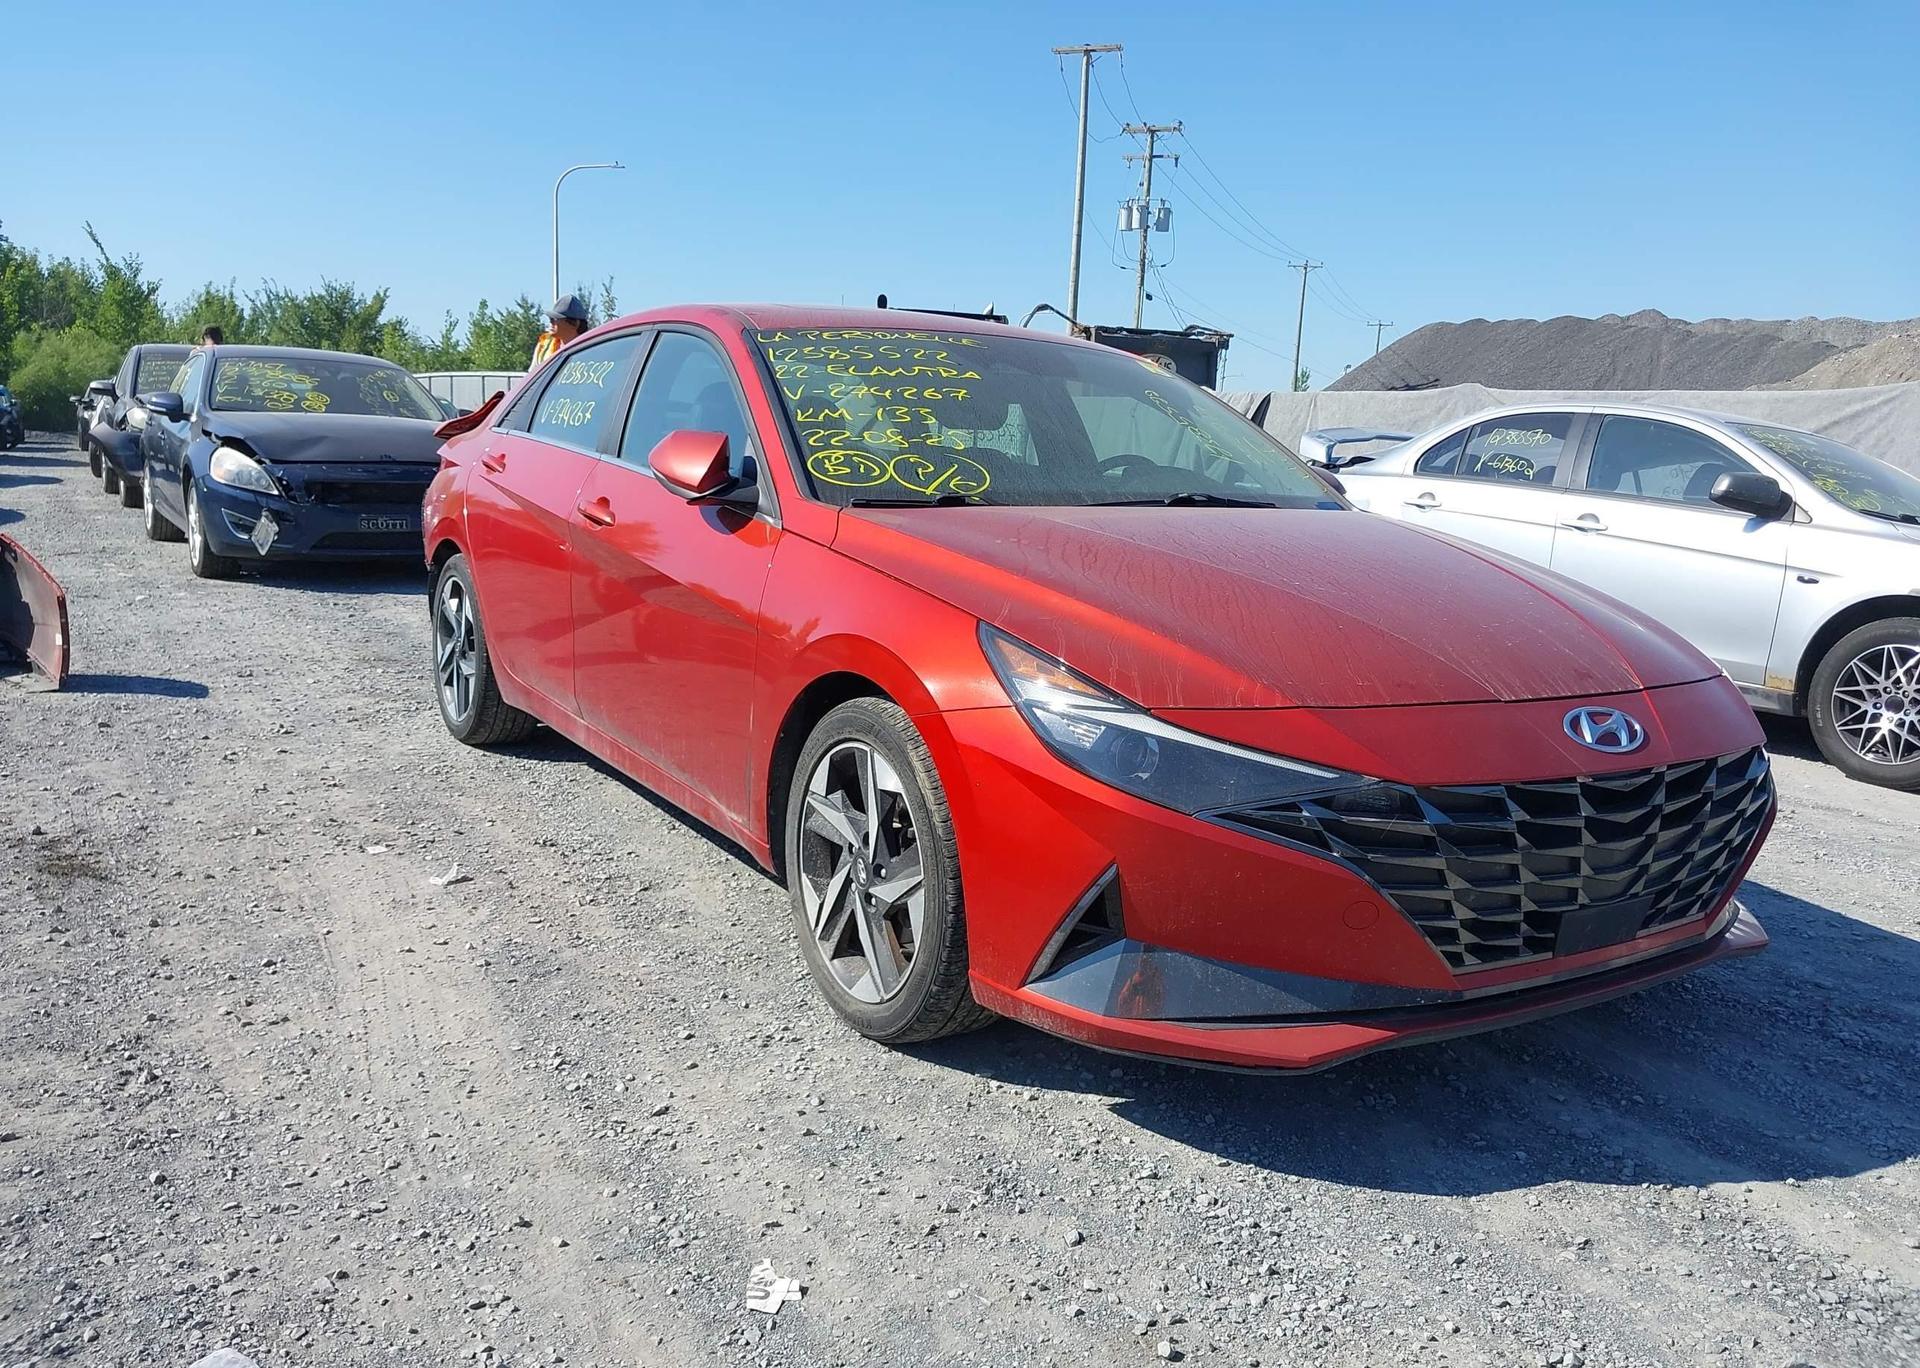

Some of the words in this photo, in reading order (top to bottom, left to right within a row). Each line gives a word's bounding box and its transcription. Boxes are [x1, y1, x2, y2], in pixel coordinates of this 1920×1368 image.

[756, 331, 792, 343] LA
[767, 345, 962, 366] 12385522
[360, 519, 408, 529] SCOTTI
